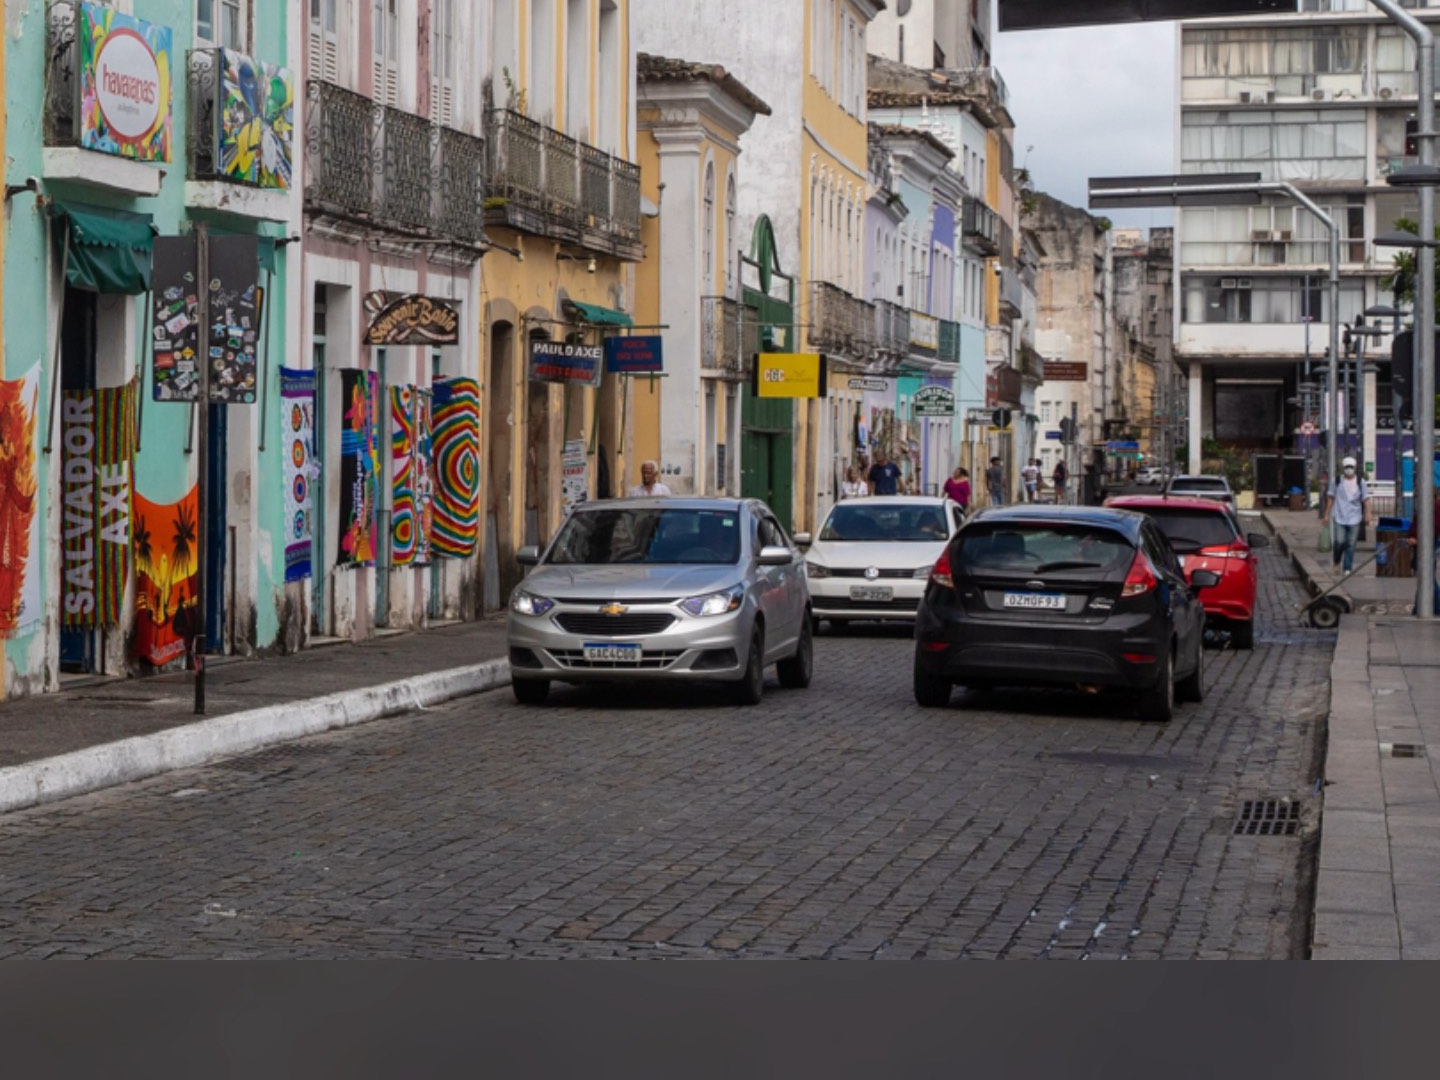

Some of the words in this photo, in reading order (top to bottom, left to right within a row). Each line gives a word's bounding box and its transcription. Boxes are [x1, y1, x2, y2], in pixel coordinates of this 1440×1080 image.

[103, 63, 157, 104] havaianas
[407, 298, 456, 332] Bahia
[533, 343, 573, 356] PAULO
[64, 397, 95, 615] SALVADOR
[96, 459, 129, 546] AXÉ
